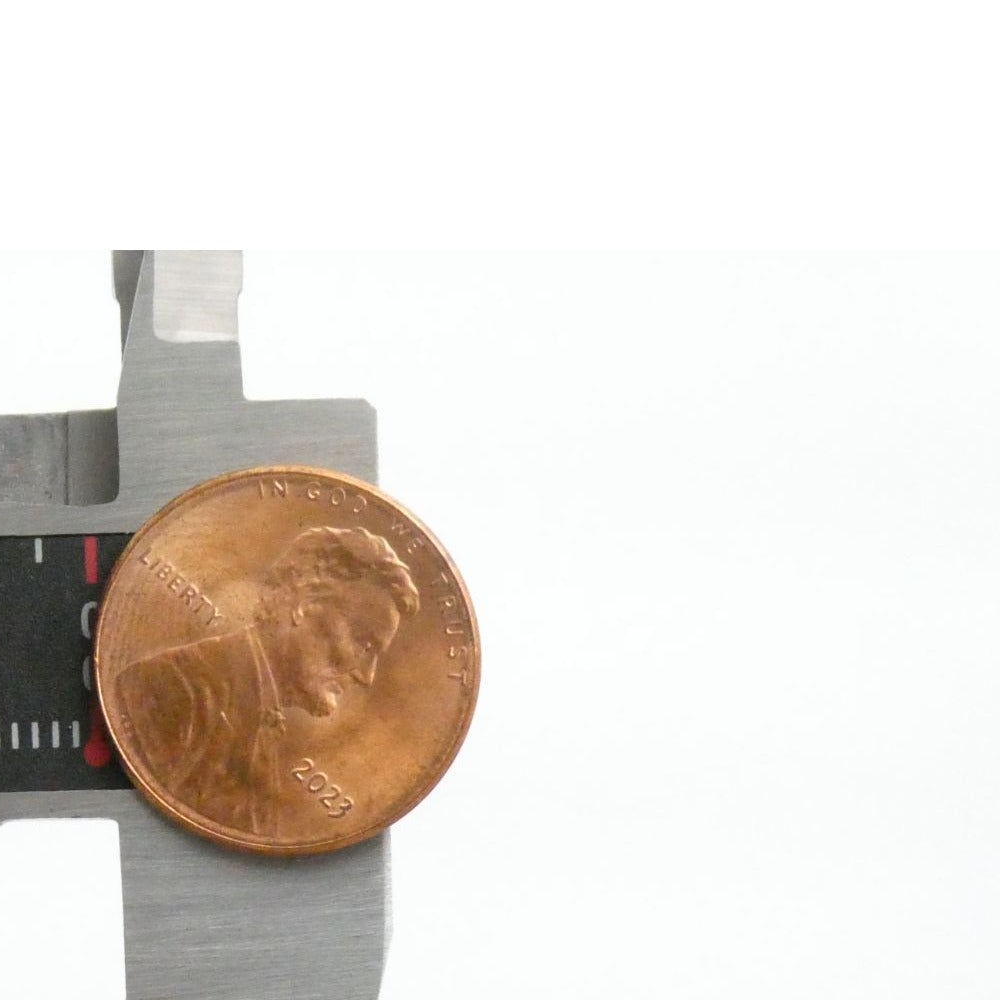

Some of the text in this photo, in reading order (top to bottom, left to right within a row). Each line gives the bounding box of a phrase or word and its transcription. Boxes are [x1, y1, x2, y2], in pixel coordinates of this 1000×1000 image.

[139, 549, 223, 627] LIBERTY
[258, 479, 469, 686] IN GOD WE TRUST
[291, 757, 354, 818] 2023
